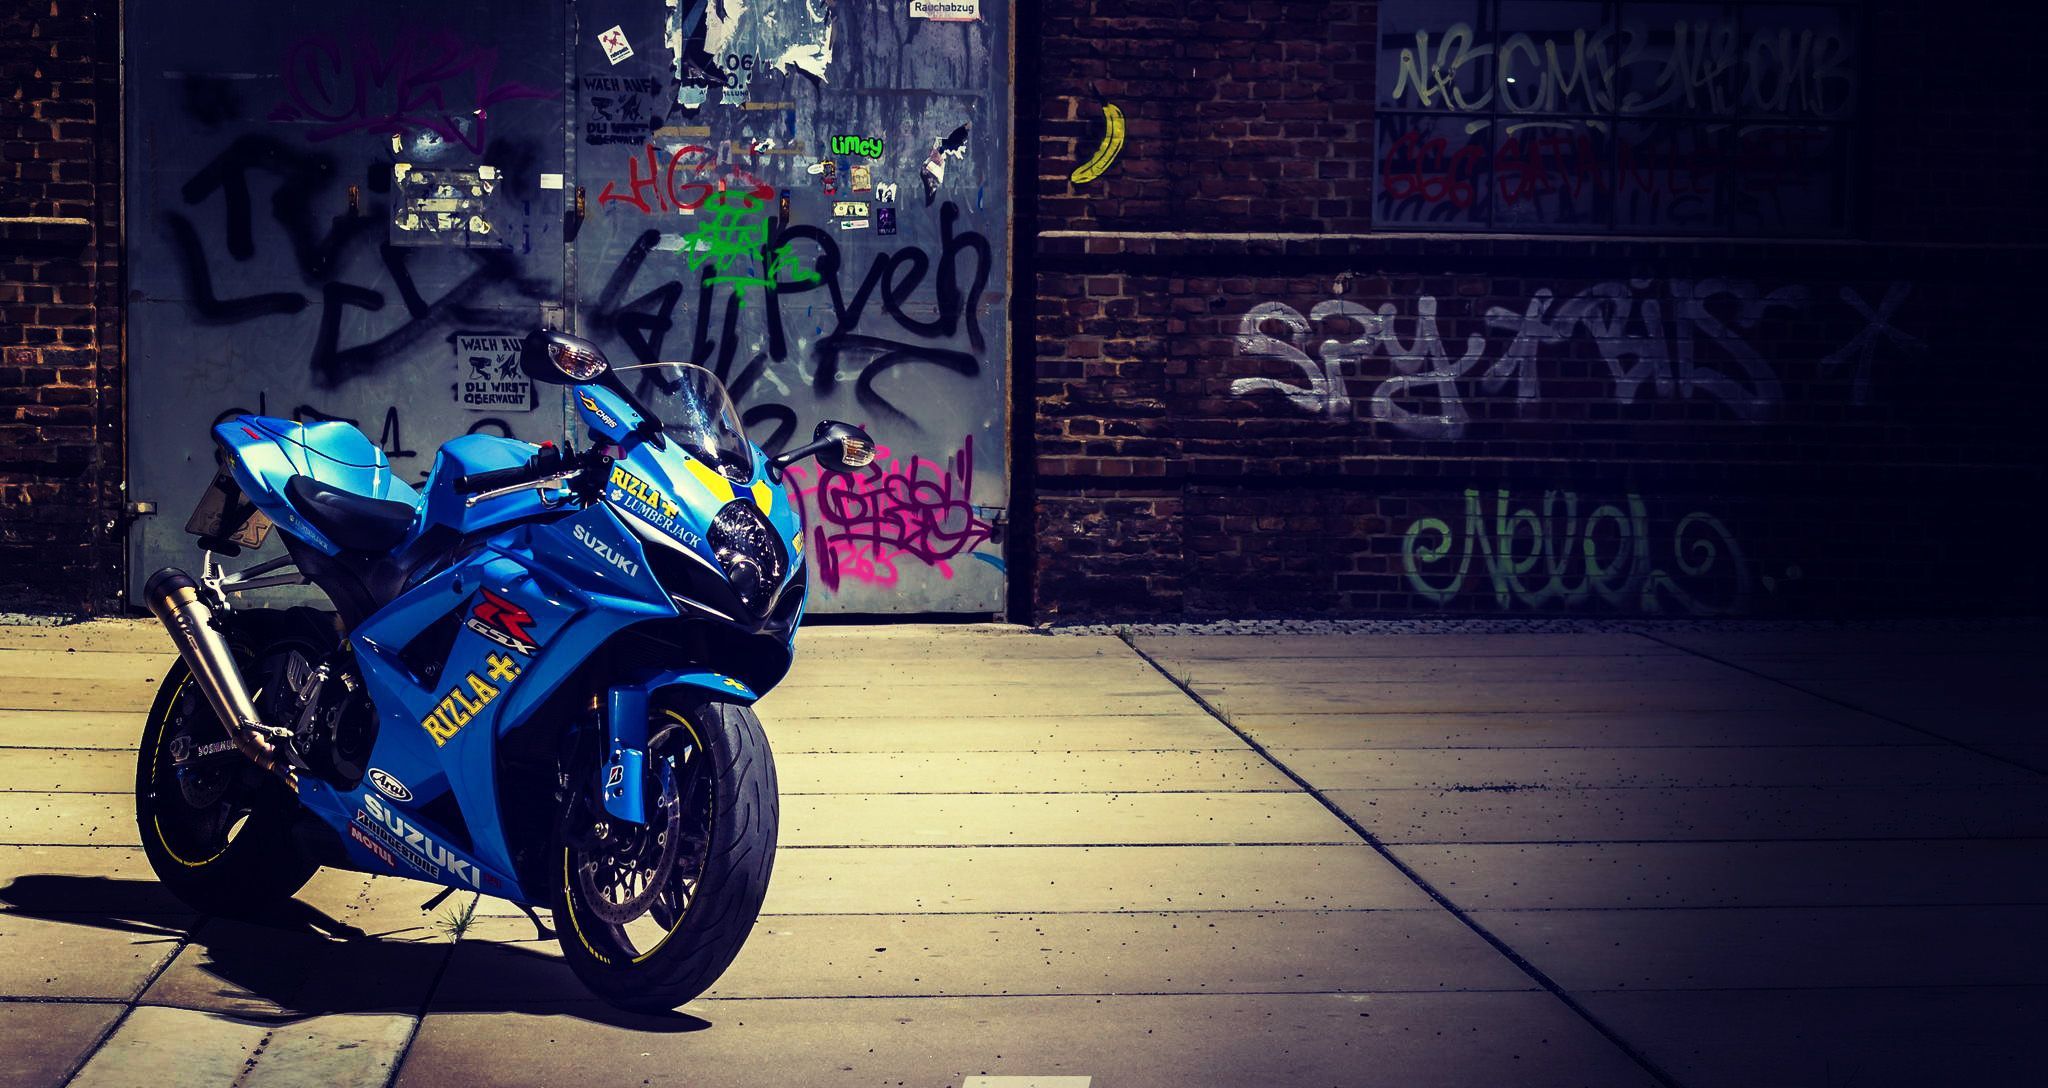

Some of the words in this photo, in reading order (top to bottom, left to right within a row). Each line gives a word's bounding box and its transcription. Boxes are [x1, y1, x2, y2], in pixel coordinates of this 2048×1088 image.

[915, 2, 975, 15] Rauchabzug
[584, 78, 620, 91] WACH
[623, 79, 651, 93] AUF
[1383, 131, 1484, 207] 666
[461, 338, 497, 351] WACH
[465, 382, 486, 393] DU
[491, 382, 529, 394] WIRST
[1230, 296, 1485, 440] SPY
[623, 495, 702, 549] LUMBERJACK
[573, 523, 639, 577] SUZUKI
[466, 618, 538, 655] GSX
[374, 774, 407, 797] Arai
[351, 827, 396, 867] MOTUL
[357, 809, 440, 880] BRIDGESTONE
[364, 793, 481, 890] SUZUKI
